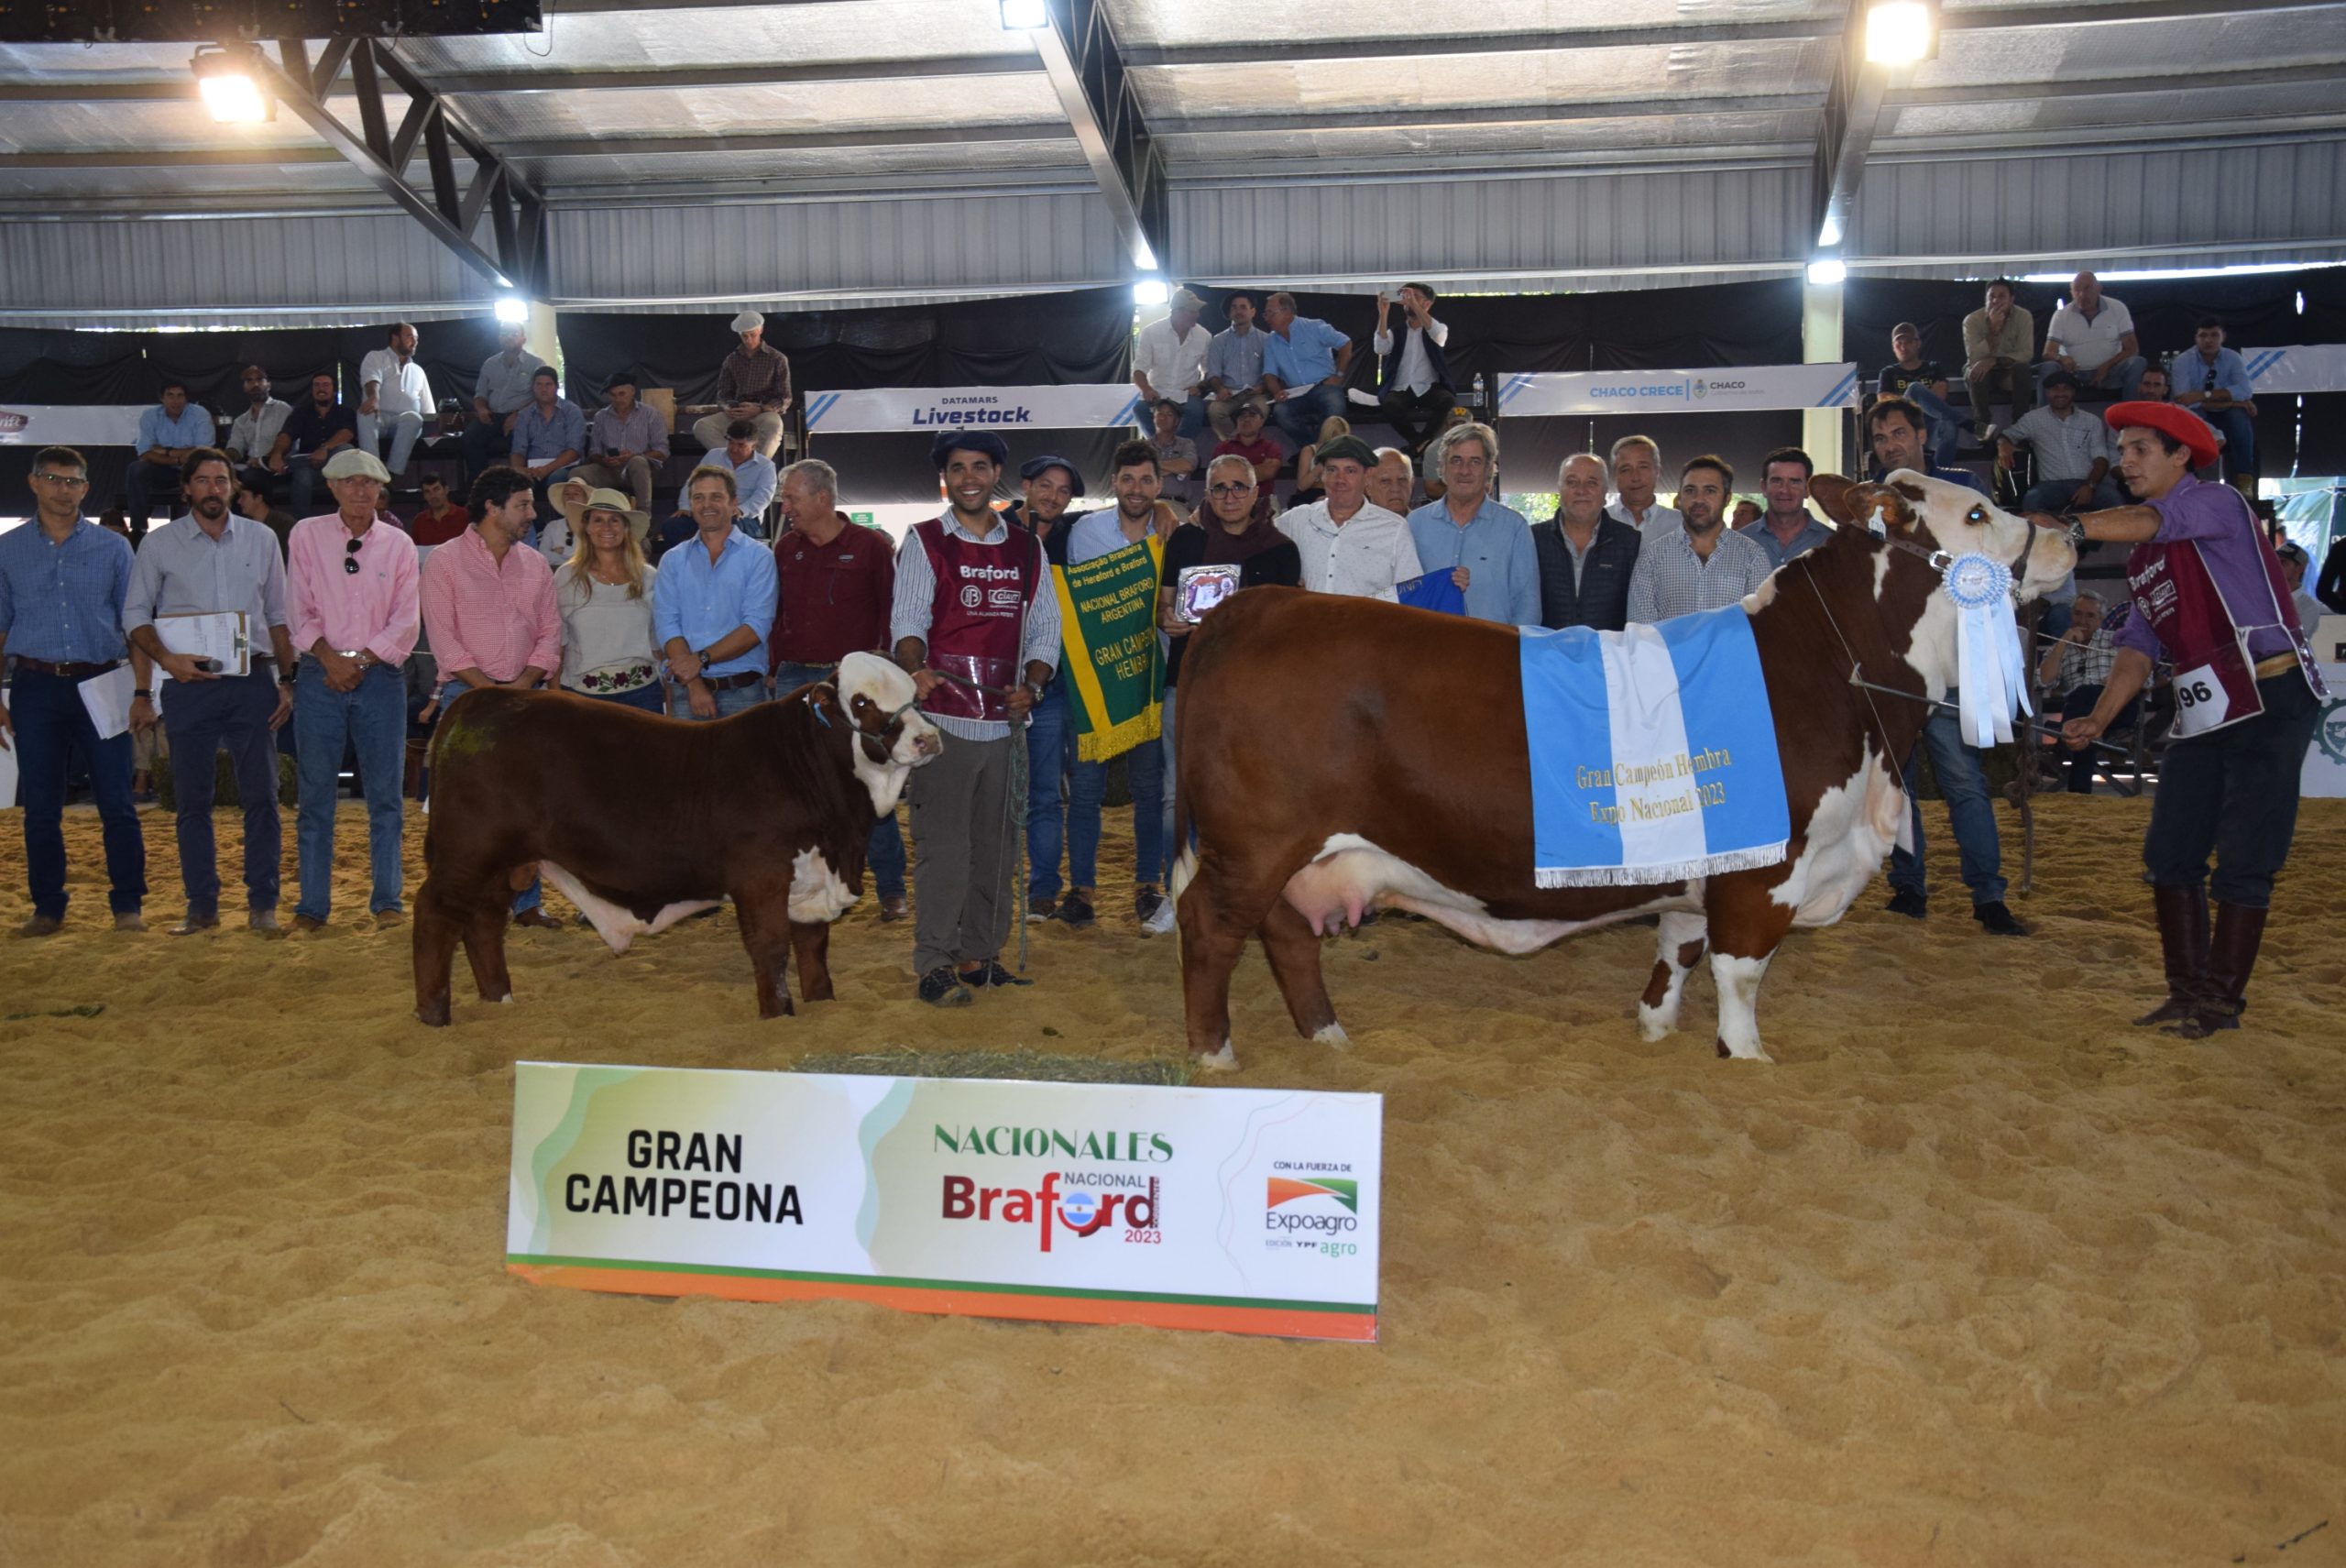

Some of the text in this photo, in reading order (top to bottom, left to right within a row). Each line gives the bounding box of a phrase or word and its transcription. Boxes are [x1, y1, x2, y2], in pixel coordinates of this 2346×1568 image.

[942, 396, 998, 405] DATAMARS
[1590, 385, 1683, 398] CHACO CRECE
[913, 406, 1029, 425] Livestock
[959, 565, 1020, 582] Braford
[2128, 554, 2165, 592] Braford
[1080, 592, 1120, 613] NACIONAL
[1101, 597, 1146, 624] ARGENTINA
[1095, 641, 1124, 666] GRAN
[1575, 747, 1731, 789] Gran Campeón Hembra
[1629, 790, 1694, 822] Nacional
[627, 1129, 742, 1173] GRAN
[934, 1124, 1173, 1163] NACIONALES
[1274, 1161, 1352, 1172] CON LA FUERZA DE
[1064, 1171, 1146, 1189] NACIONAL
[565, 1173, 804, 1224] CAMPEONA
[1266, 1212, 1357, 1235] Expoagro
[1124, 1229, 1162, 1244] 2023
[1320, 1242, 1357, 1258] agro
